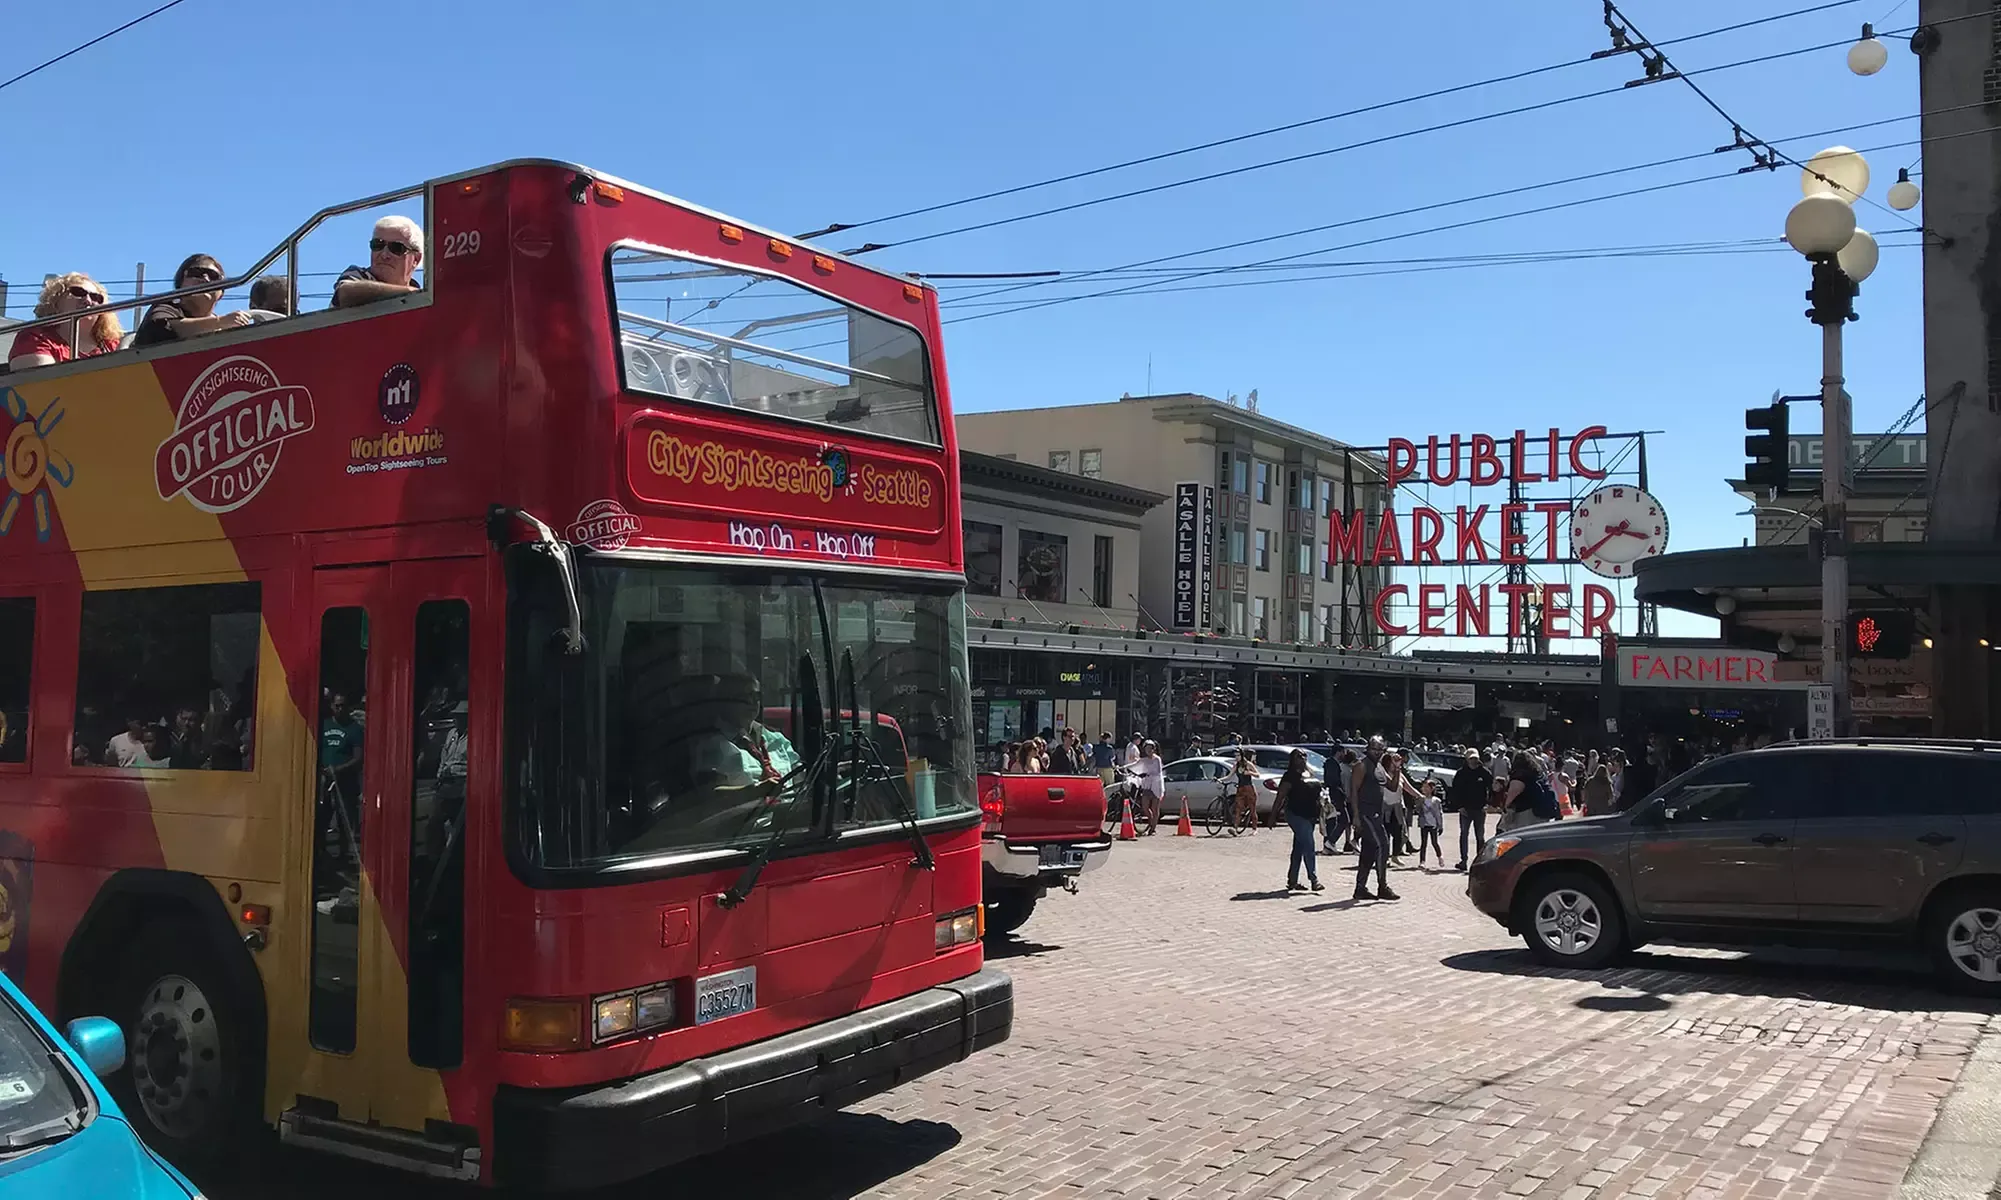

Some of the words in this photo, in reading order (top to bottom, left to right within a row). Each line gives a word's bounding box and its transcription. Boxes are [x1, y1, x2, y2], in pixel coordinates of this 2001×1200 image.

[443, 230, 481, 259] 229
[188, 366, 269, 419] CITYSIGHTSEEING
[170, 393, 305, 483] OFFICIAL
[350, 427, 444, 459] Worldwide
[380, 458, 425, 471] Sightseeing
[425, 456, 448, 466] Tours
[1387, 425, 1607, 489] PUBLIC
[210, 452, 270, 499] TOUR
[862, 463, 932, 508] Seattle
[1179, 486, 1194, 507] LA
[1204, 488, 1212, 509] LA
[1593, 494, 1602, 504] 11
[1612, 488, 1624, 499] 12
[1579, 508, 1590, 518] 10
[1649, 507, 1657, 517] 2
[575, 517, 639, 541] OFFICIAL
[729, 521, 766, 551] Hop
[770, 523, 794, 550] On
[816, 532, 848, 559] Hop
[851, 533, 875, 558] Off
[1178, 511, 1194, 563] SALLE
[1203, 514, 1212, 566] SALLE
[1327, 502, 1571, 566] MARKET
[1574, 527, 1582, 537] 9
[1654, 525, 1662, 536] 3
[1647, 545, 1657, 555] 4
[1593, 559, 1602, 570] 7
[1613, 565, 1622, 575] 6
[1177, 570, 1192, 623] HOTEL
[1202, 571, 1211, 623] HOTEL
[1373, 584, 1617, 639] CENTER
[1060, 672, 1081, 683] CHASE
[1631, 654, 1778, 683] FARMER
[1016, 688, 1046, 696] INFORMATION
